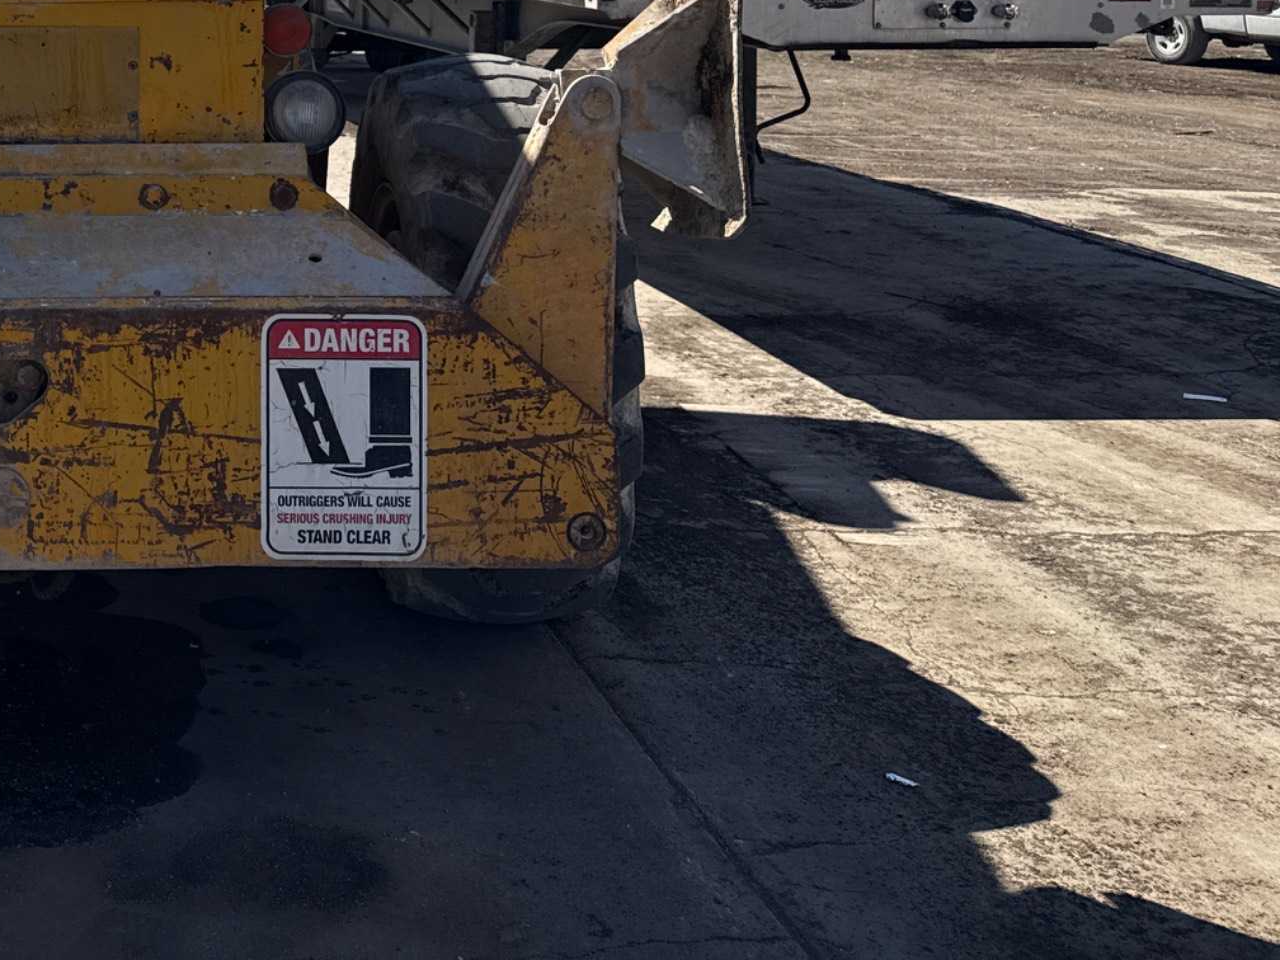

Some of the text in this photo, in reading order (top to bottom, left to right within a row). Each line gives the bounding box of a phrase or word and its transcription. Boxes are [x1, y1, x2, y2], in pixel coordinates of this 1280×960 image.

[304, 328, 410, 353] DANGER
[277, 495, 411, 508] OUTRIGGERS WILL CAUSE
[277, 513, 411, 525] SERIOUS CRUSHING INJURY
[297, 529, 391, 545] STAND CLEAR
